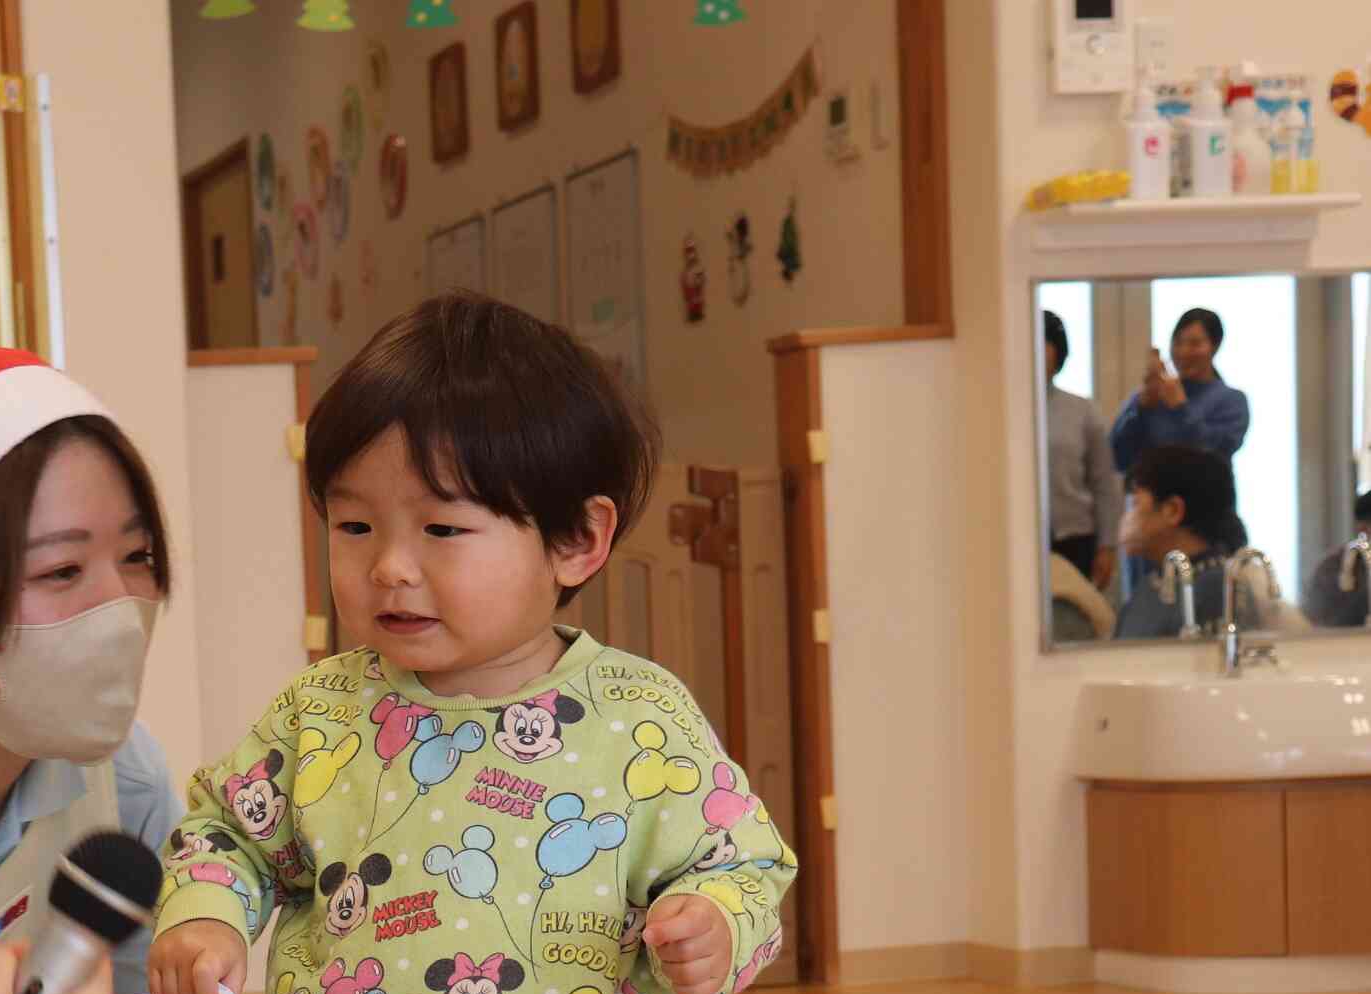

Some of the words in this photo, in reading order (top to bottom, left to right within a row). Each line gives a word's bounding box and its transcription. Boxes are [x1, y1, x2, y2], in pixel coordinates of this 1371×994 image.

[603, 684, 677, 714] GOOD
[474, 766, 548, 803] MINNIE
[465, 785, 536, 820] MOUSE
[373, 889, 439, 925] MICKEY
[374, 909, 443, 943] MOUSE
[541, 911, 574, 934] HI,
[578, 911, 623, 942] HELL
[543, 943, 608, 971] GOOD
